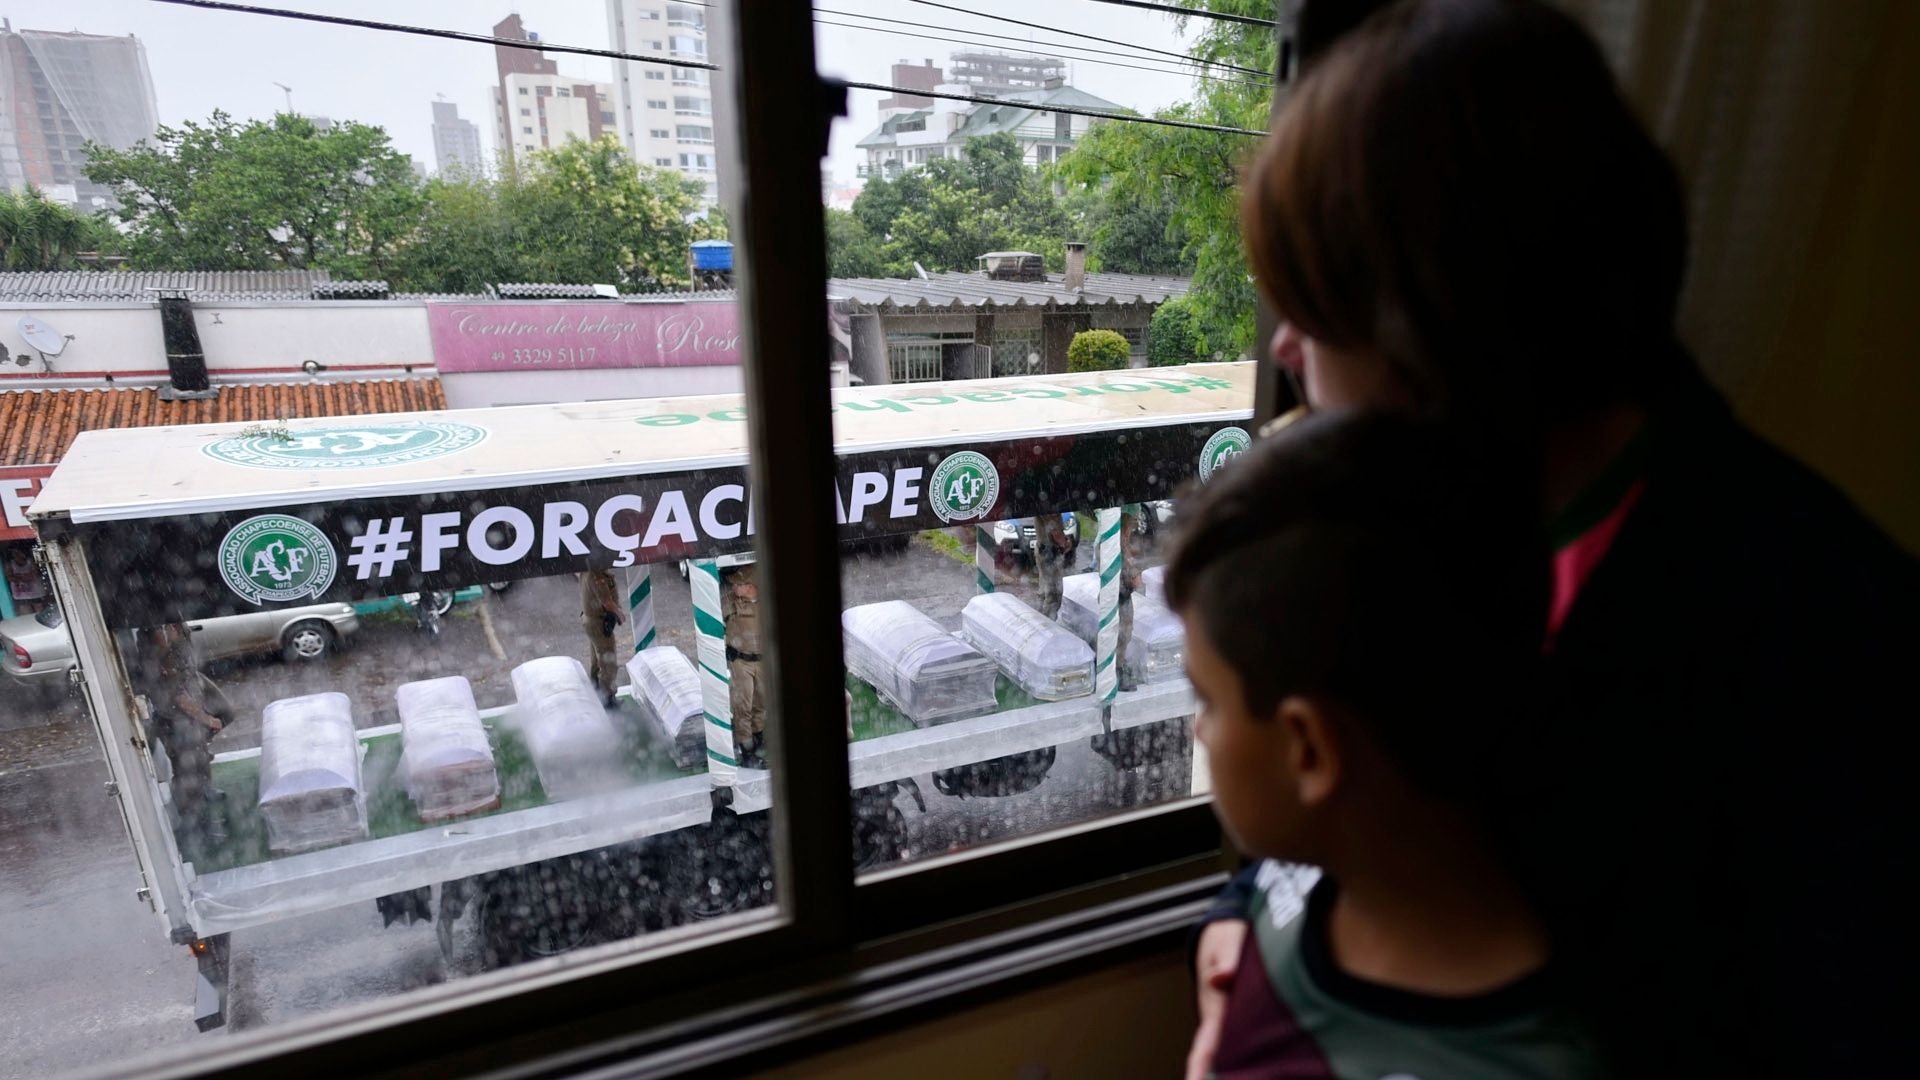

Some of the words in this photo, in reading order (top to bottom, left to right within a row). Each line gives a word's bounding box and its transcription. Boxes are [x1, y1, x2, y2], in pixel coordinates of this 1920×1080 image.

[450, 310, 539, 337] Centro
[545, 314, 571, 335] de
[577, 314, 638, 342] beleza
[512, 348, 552, 364] 3329
[557, 347, 596, 363] 5117
[947, 471, 984, 504] ACF
[236, 519, 311, 541] CHAPECOENSE
[347, 466, 923, 581] #FORÇACPE
[308, 535, 323, 549] DE
[226, 540, 255, 594] ASSOCIAÇÃO
[249, 539, 309, 582] ACF
[313, 547, 330, 585] FUTEBOL
